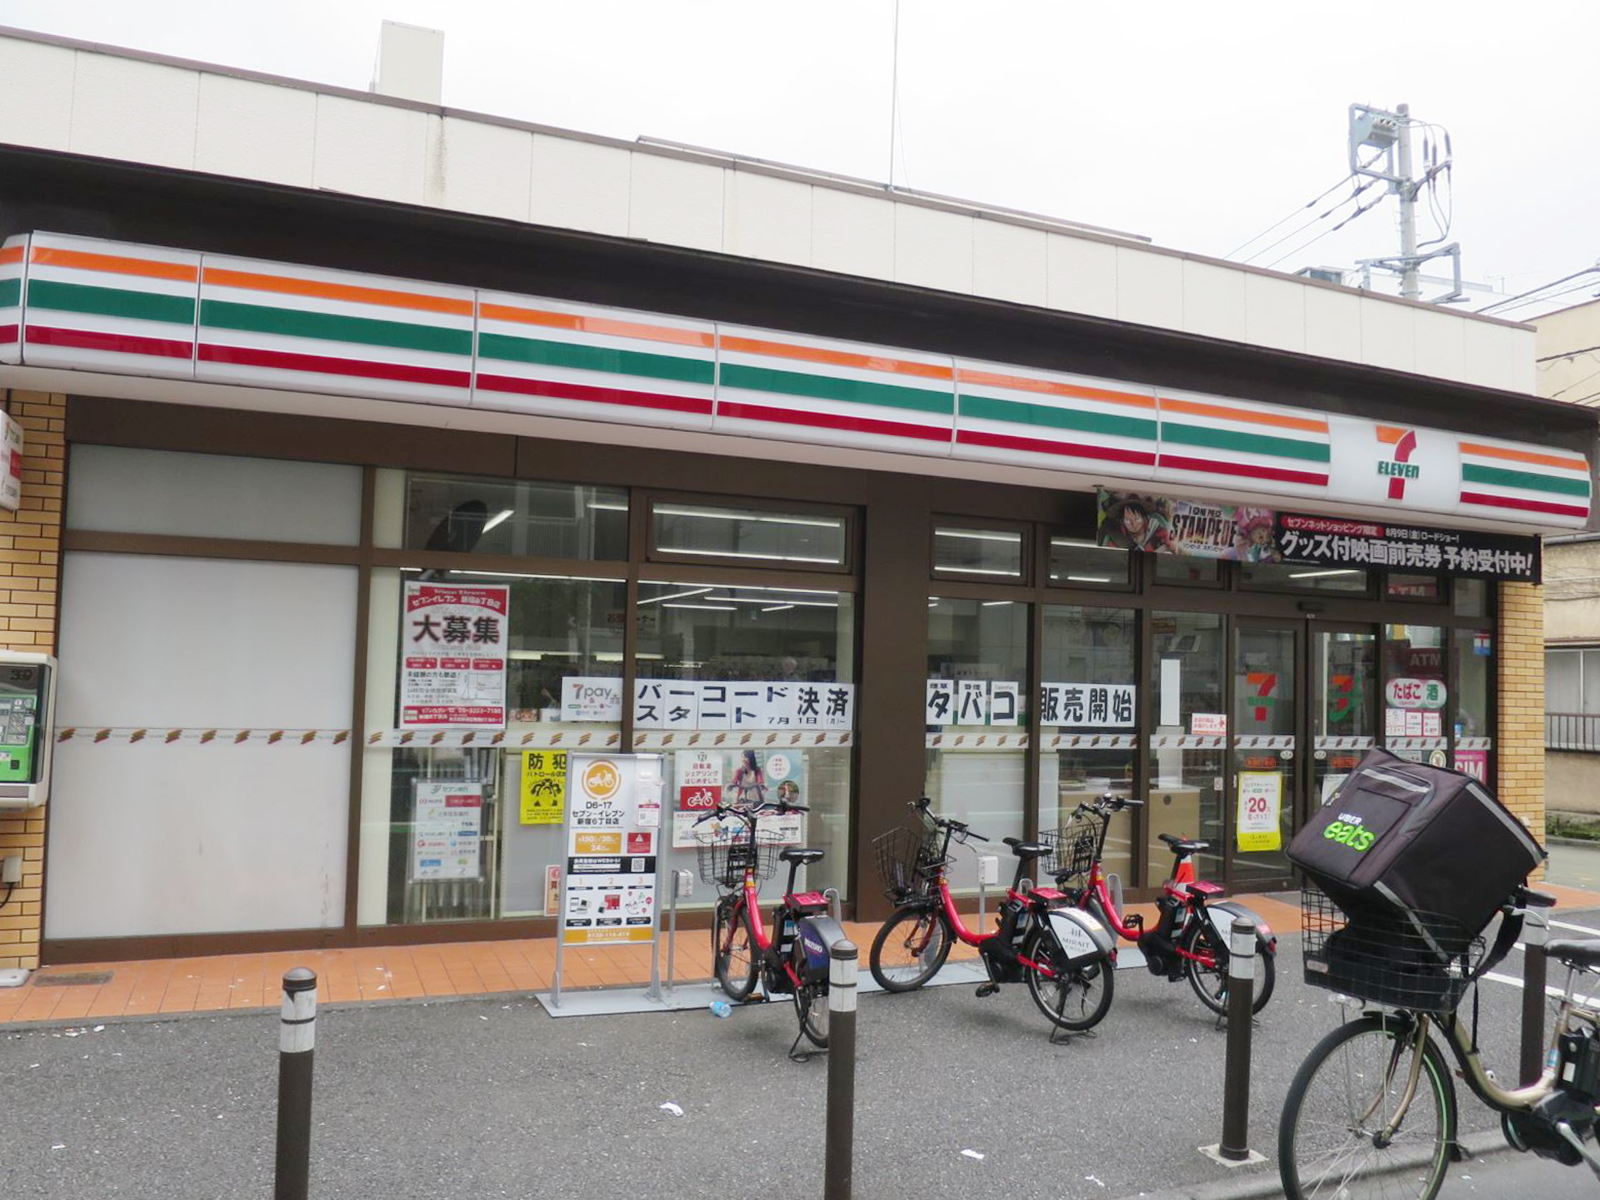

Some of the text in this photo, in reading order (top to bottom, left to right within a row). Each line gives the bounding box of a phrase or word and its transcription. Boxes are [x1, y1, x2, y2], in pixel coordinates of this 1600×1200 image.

[1171, 514, 1237, 548] STAMPEDE
[413, 614, 500, 644] 大募集
[1393, 684, 1421, 700] たばこ
[637, 704, 757, 723] スタート
[928, 687, 1133, 723] タバコ 販売開始
[585, 801, 613, 809] D6-17
[1338, 812, 1362, 825] UBER
[1324, 821, 1375, 851] eats
[1062, 937, 1090, 948] MIRAIT
